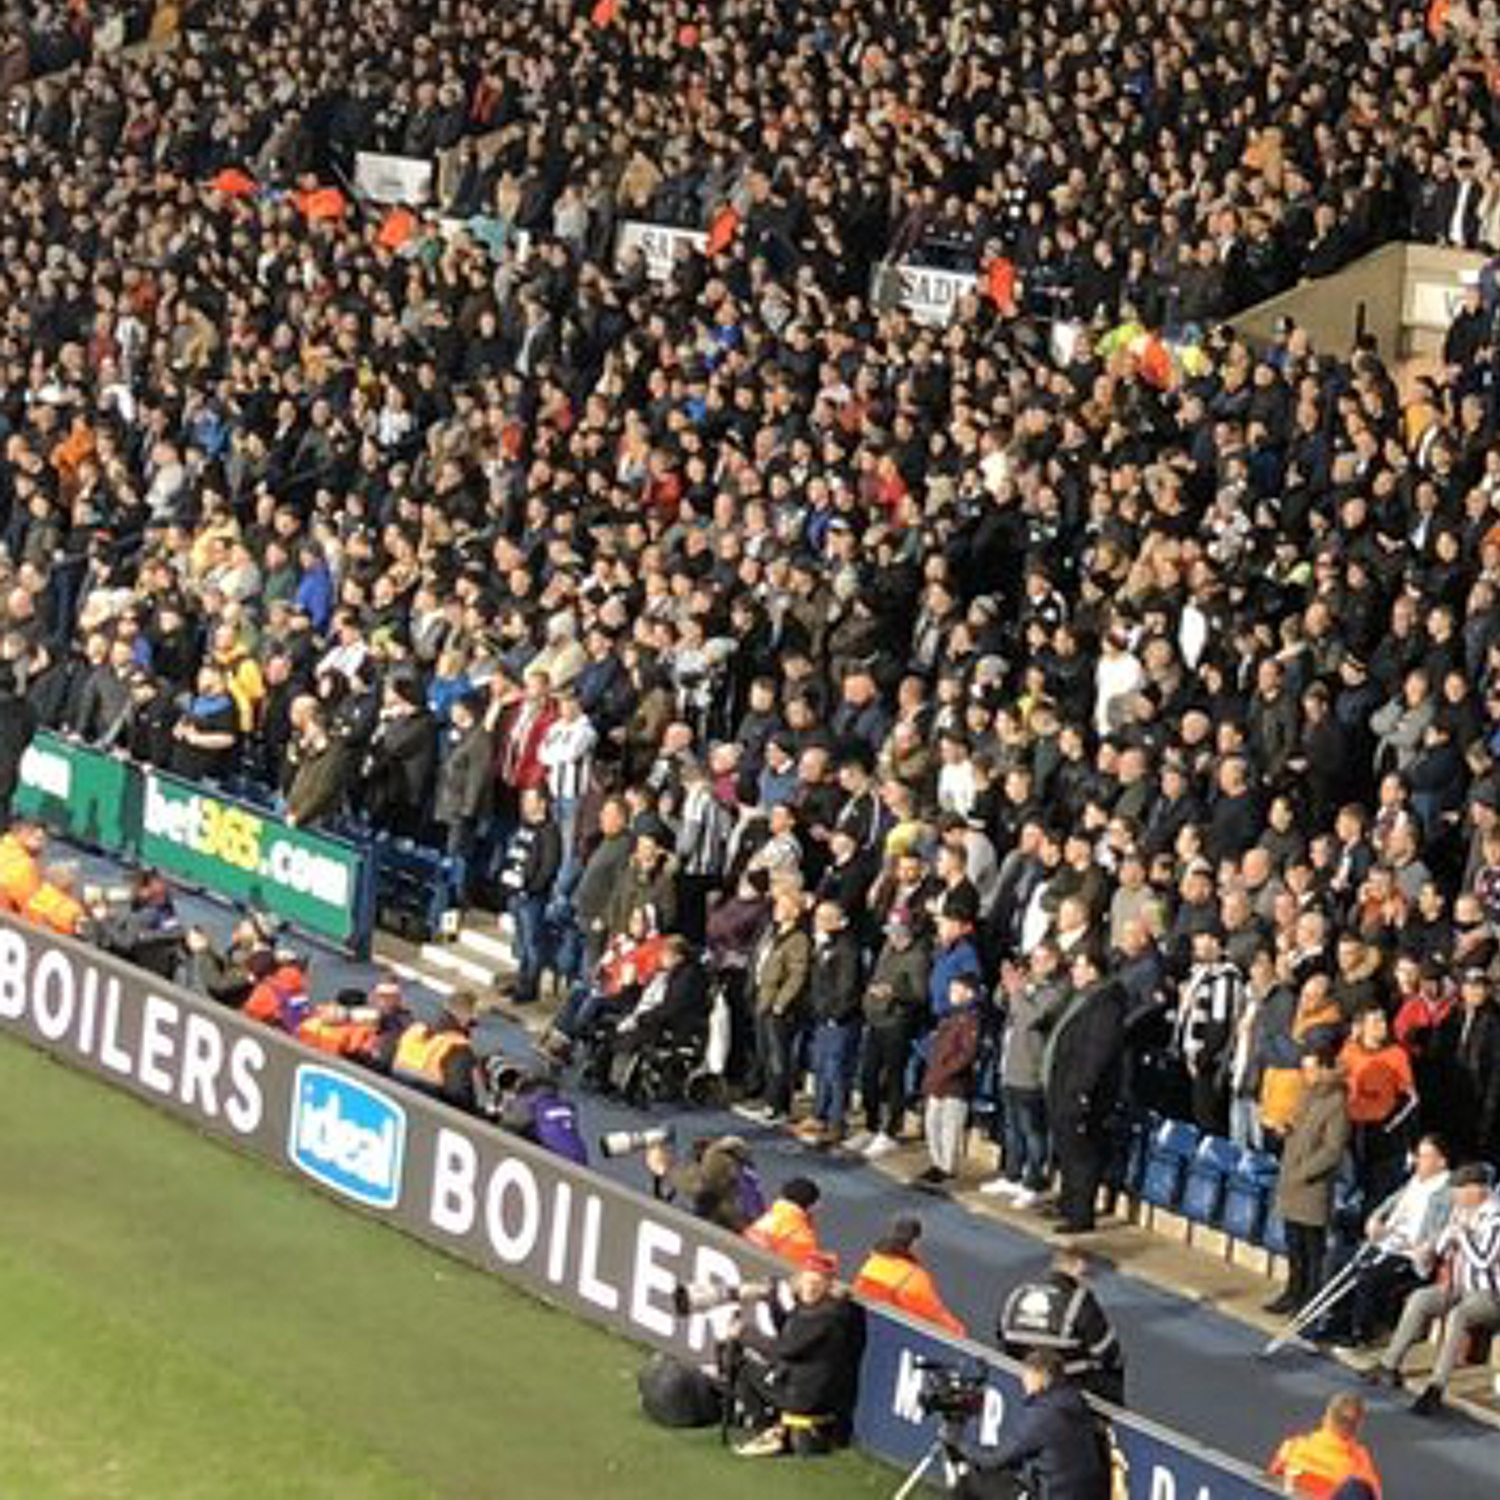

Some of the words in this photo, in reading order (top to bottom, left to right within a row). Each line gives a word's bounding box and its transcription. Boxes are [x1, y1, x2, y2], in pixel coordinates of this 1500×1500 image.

[142, 775, 350, 908] bet365.com
[0, 927, 266, 1134] BOILERS
[299, 1082, 397, 1192] ideal
